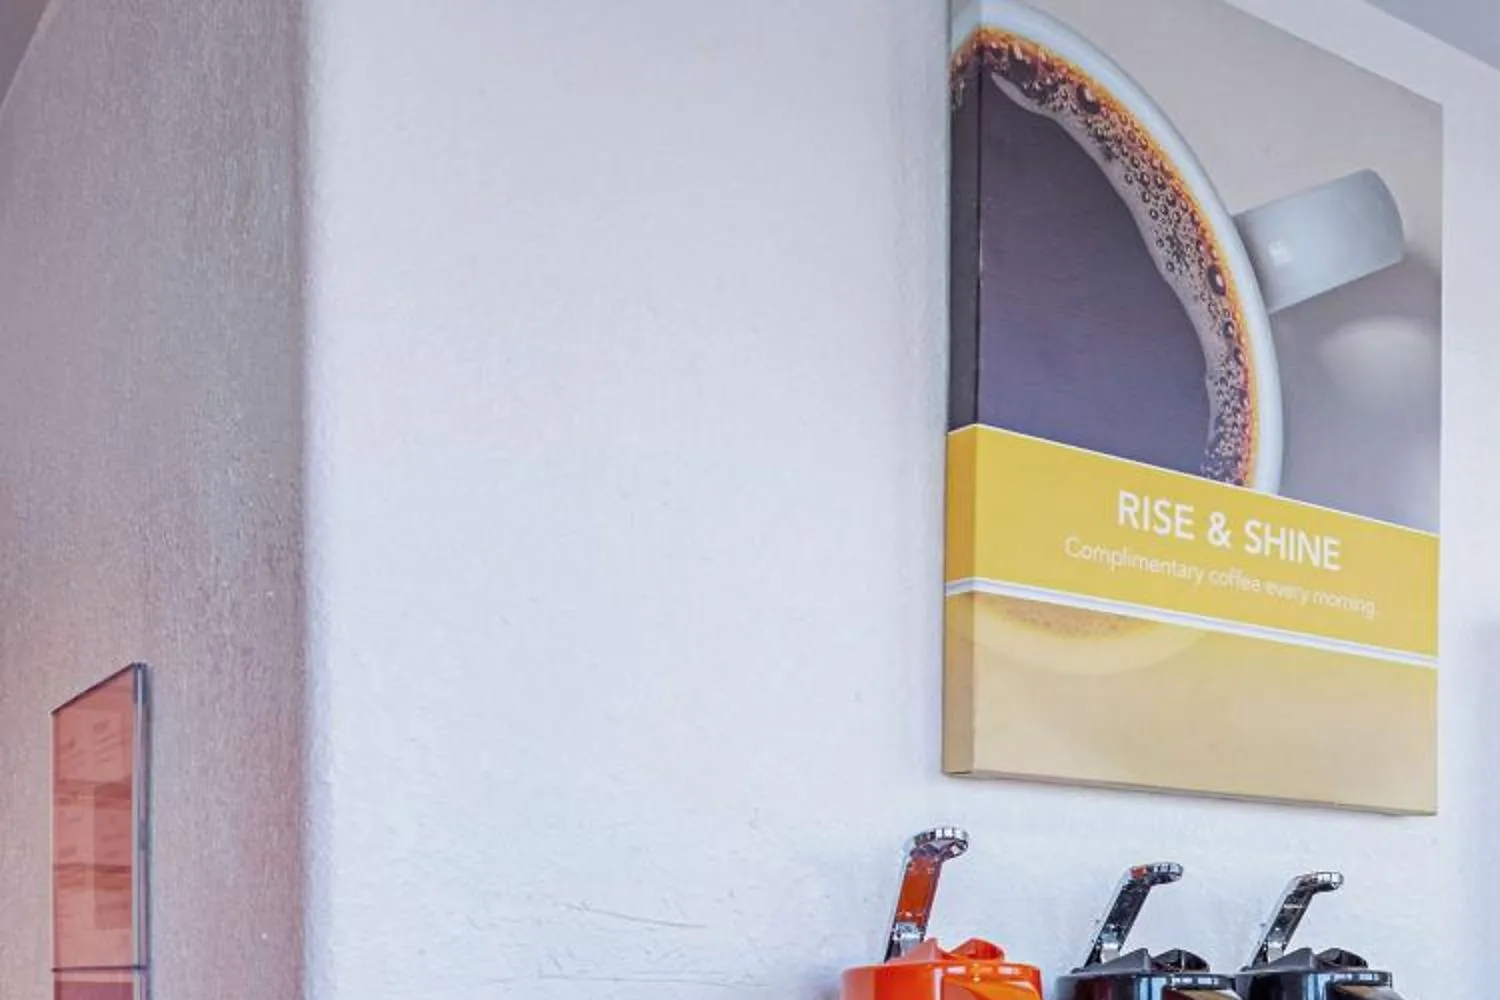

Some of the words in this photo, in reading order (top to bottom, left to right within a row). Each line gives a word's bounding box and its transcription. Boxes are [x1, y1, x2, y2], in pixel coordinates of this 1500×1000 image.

[1117, 490, 1195, 540] RISE
[1207, 511, 1232, 549] &
[1243, 519, 1342, 571] SHINE
[1064, 536, 1204, 584] Complimentary
[1208, 566, 1261, 593] coffee
[1264, 577, 1313, 605] every
